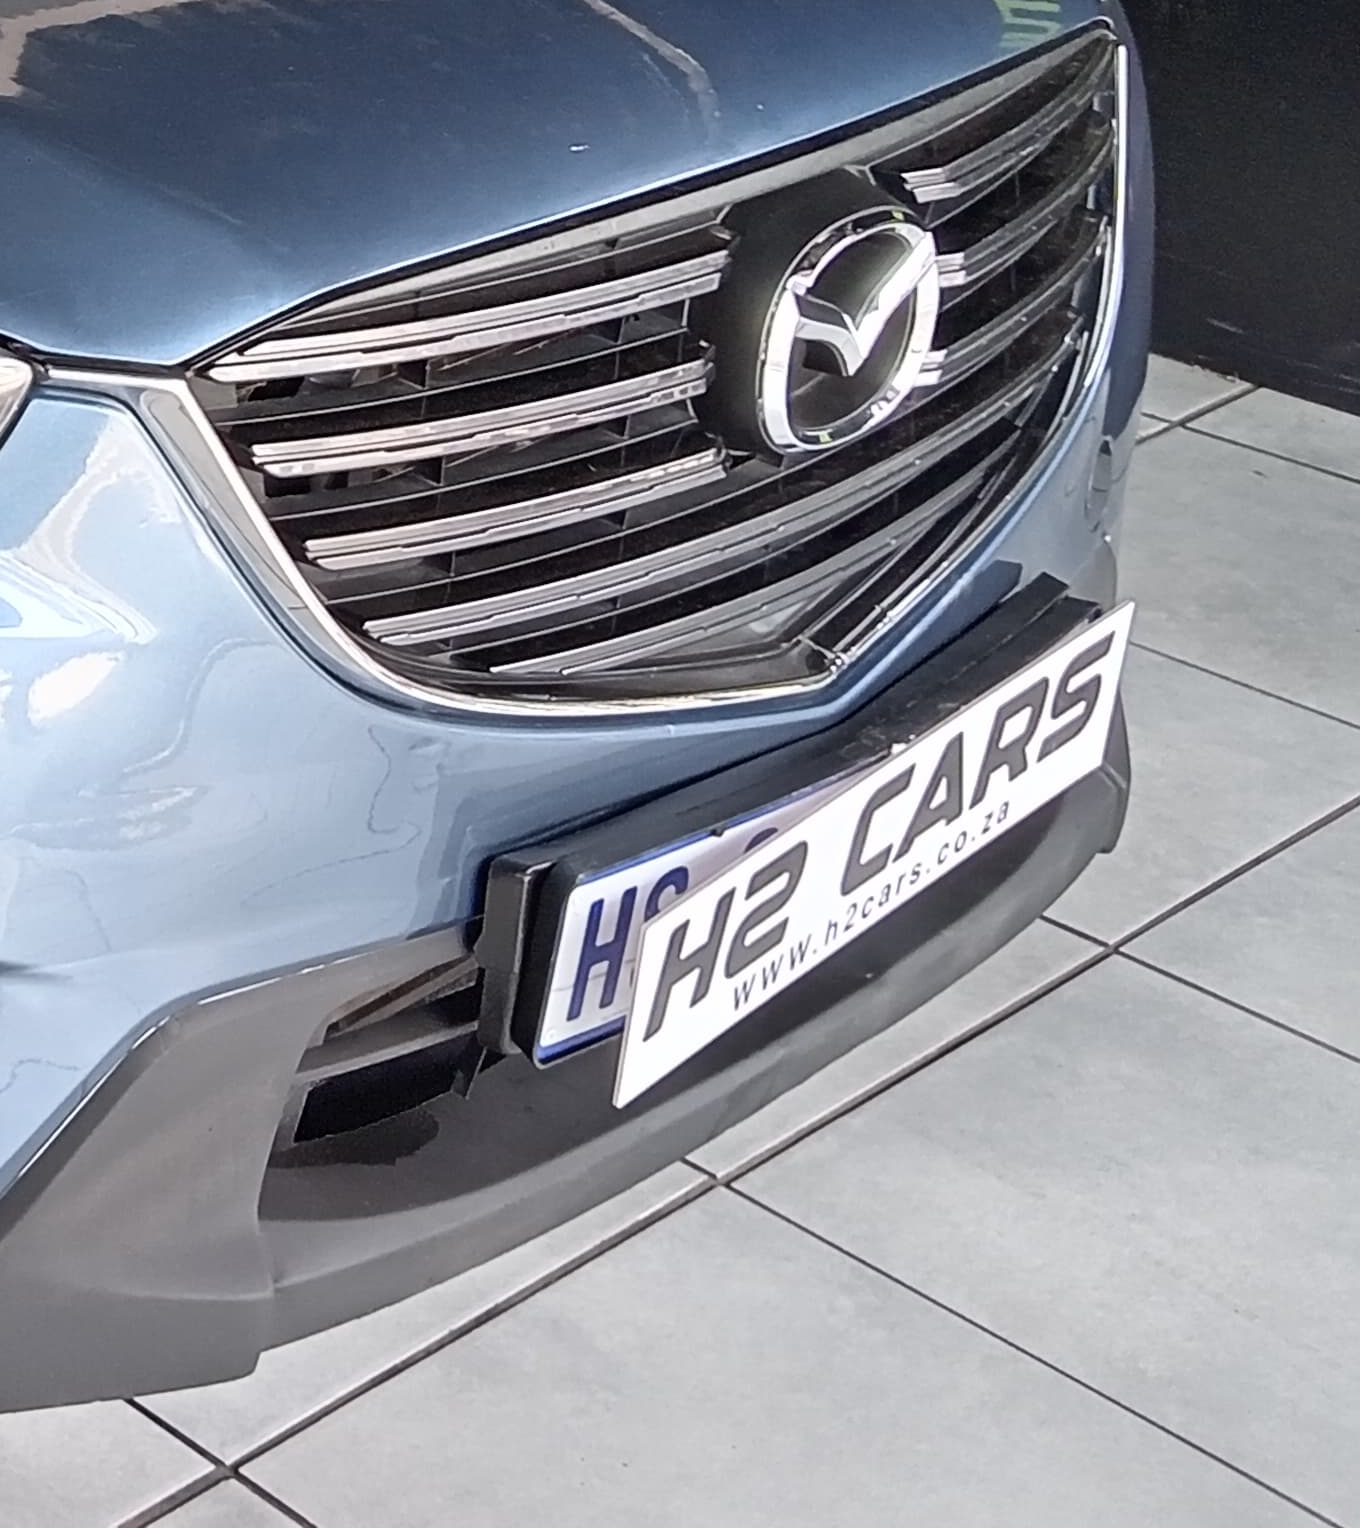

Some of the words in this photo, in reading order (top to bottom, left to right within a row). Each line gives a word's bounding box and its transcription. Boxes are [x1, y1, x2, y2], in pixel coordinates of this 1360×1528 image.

[643, 840, 808, 1043] H2
[841, 630, 1115, 896] CARS
[733, 800, 1010, 1012] www.h2cars.co.za
